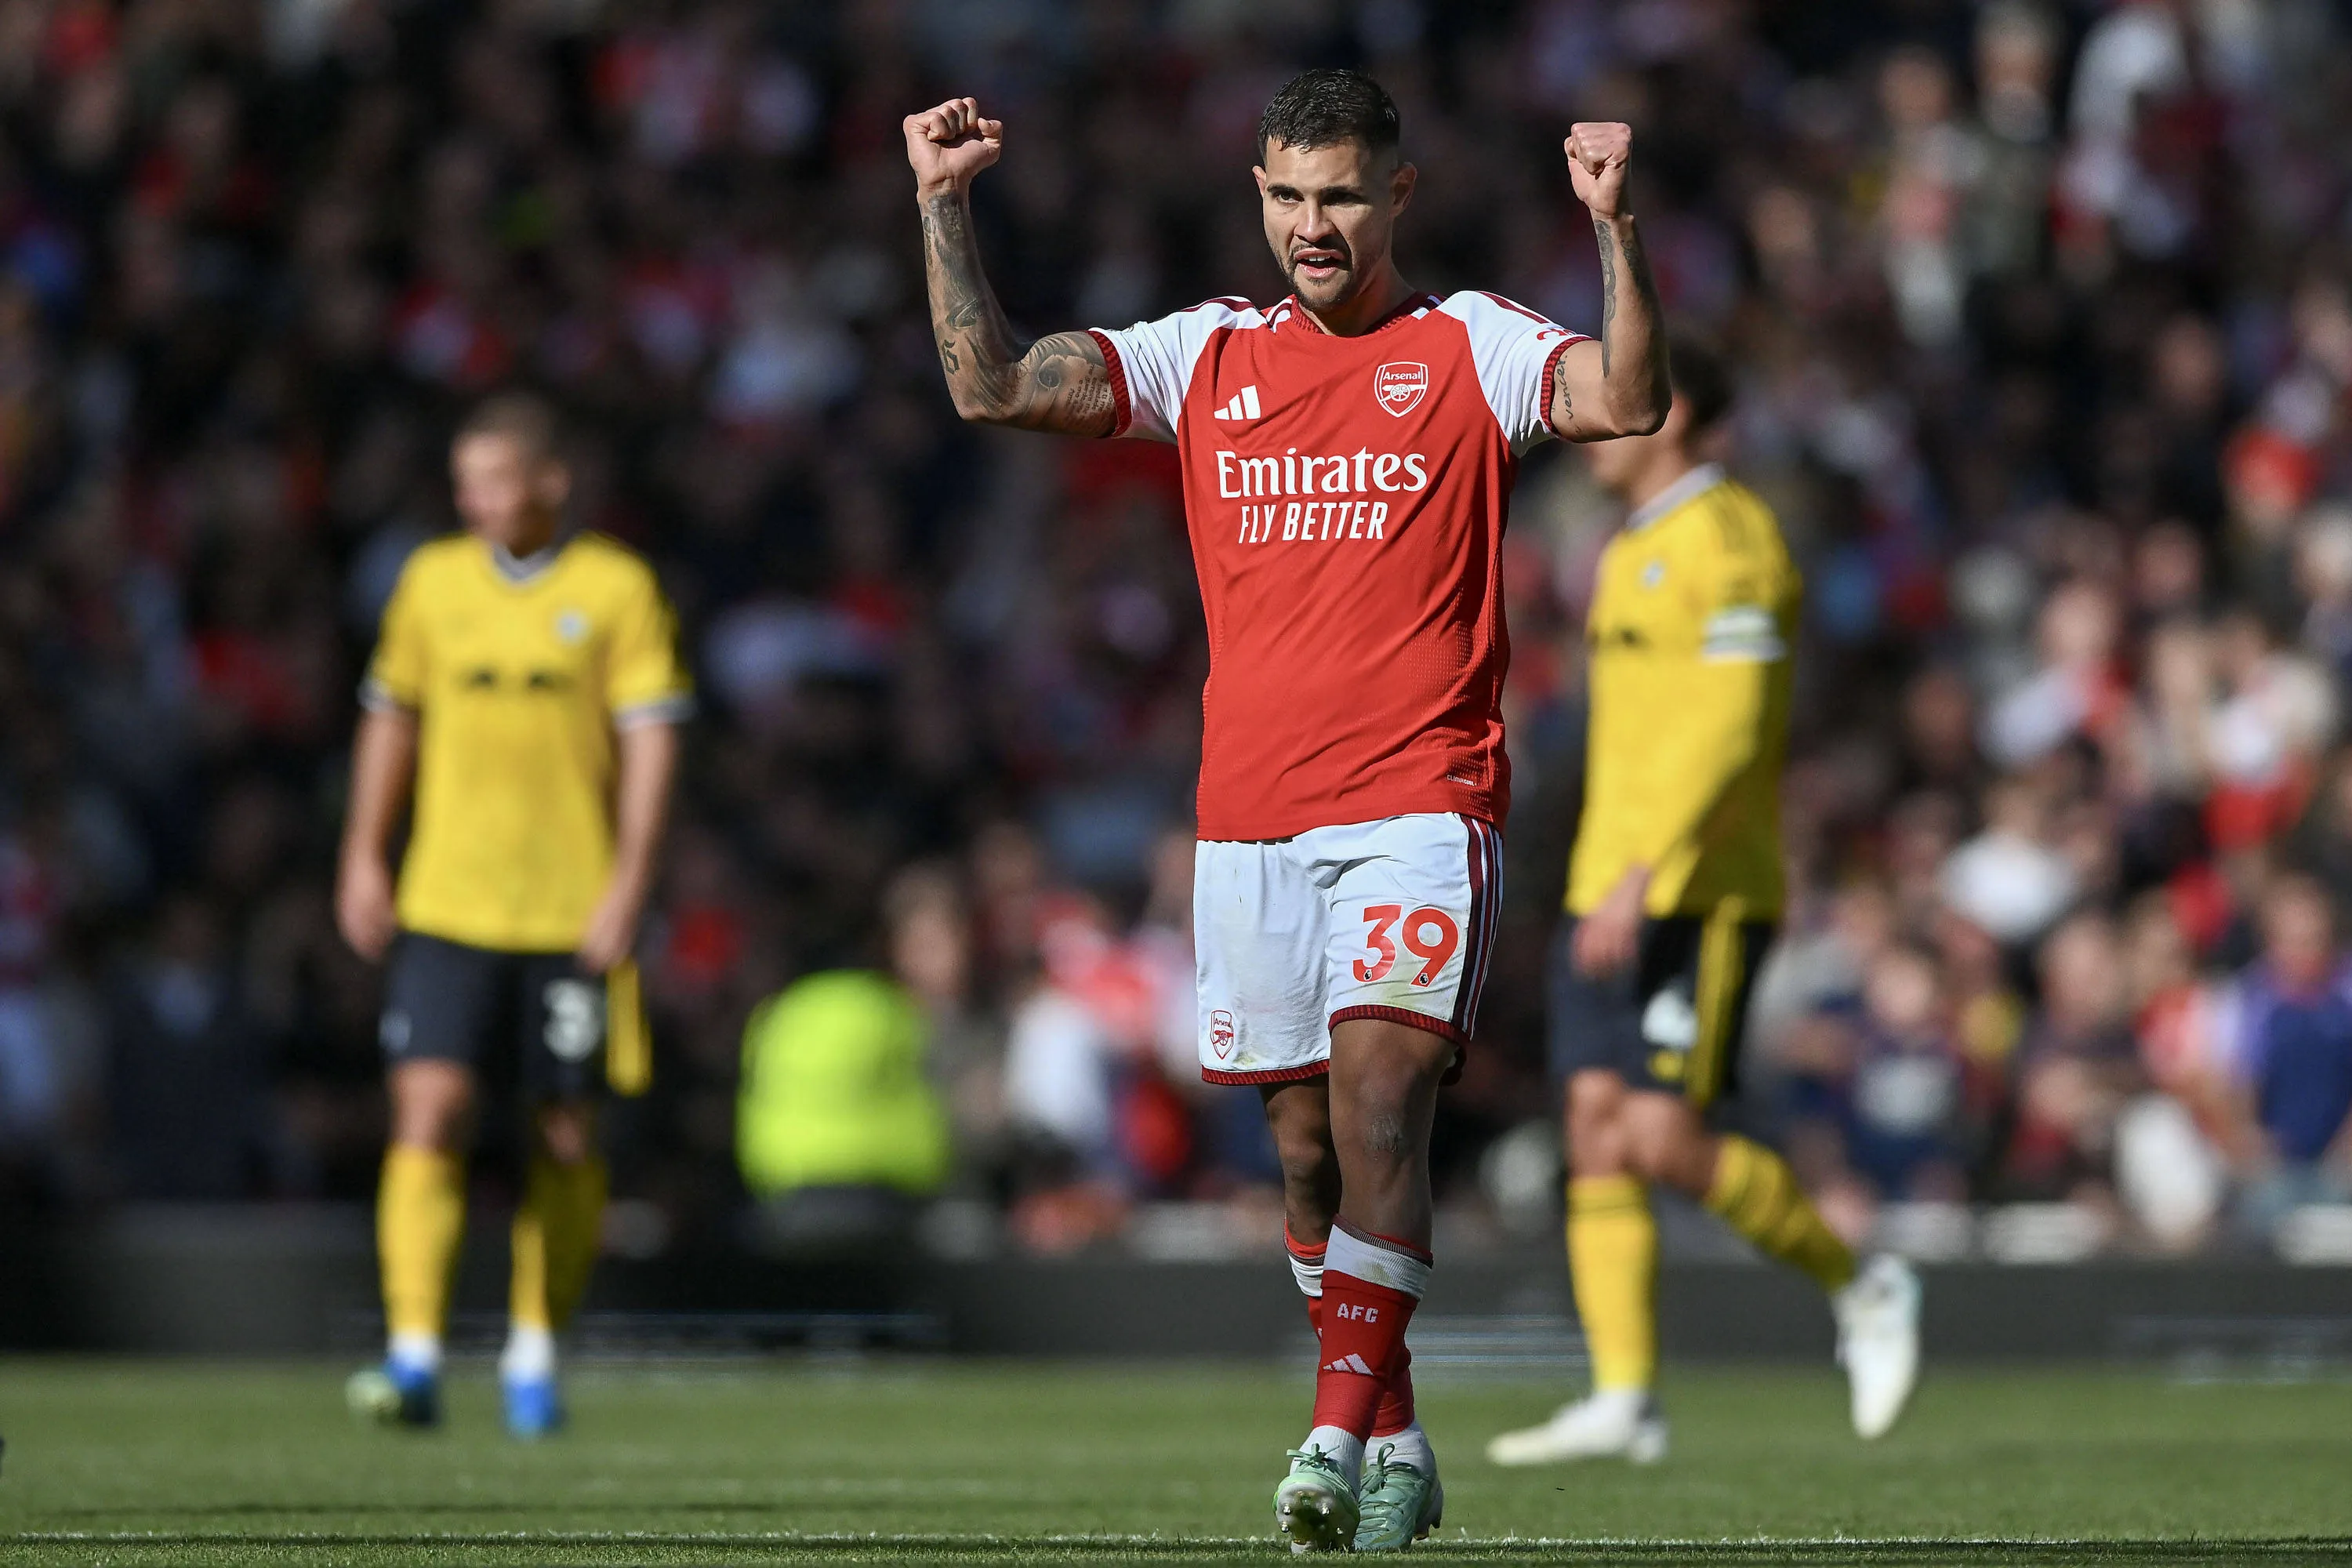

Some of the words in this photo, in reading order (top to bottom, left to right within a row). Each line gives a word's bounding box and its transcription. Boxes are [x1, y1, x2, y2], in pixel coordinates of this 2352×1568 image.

[1382, 371, 1421, 381] Arsenal
[1215, 445, 1428, 499] Emirates
[1238, 504, 1277, 544] FLY
[1282, 501, 1388, 541] BETTER
[1352, 903, 1459, 988] 39
[1337, 1302, 1378, 1323] AFC
